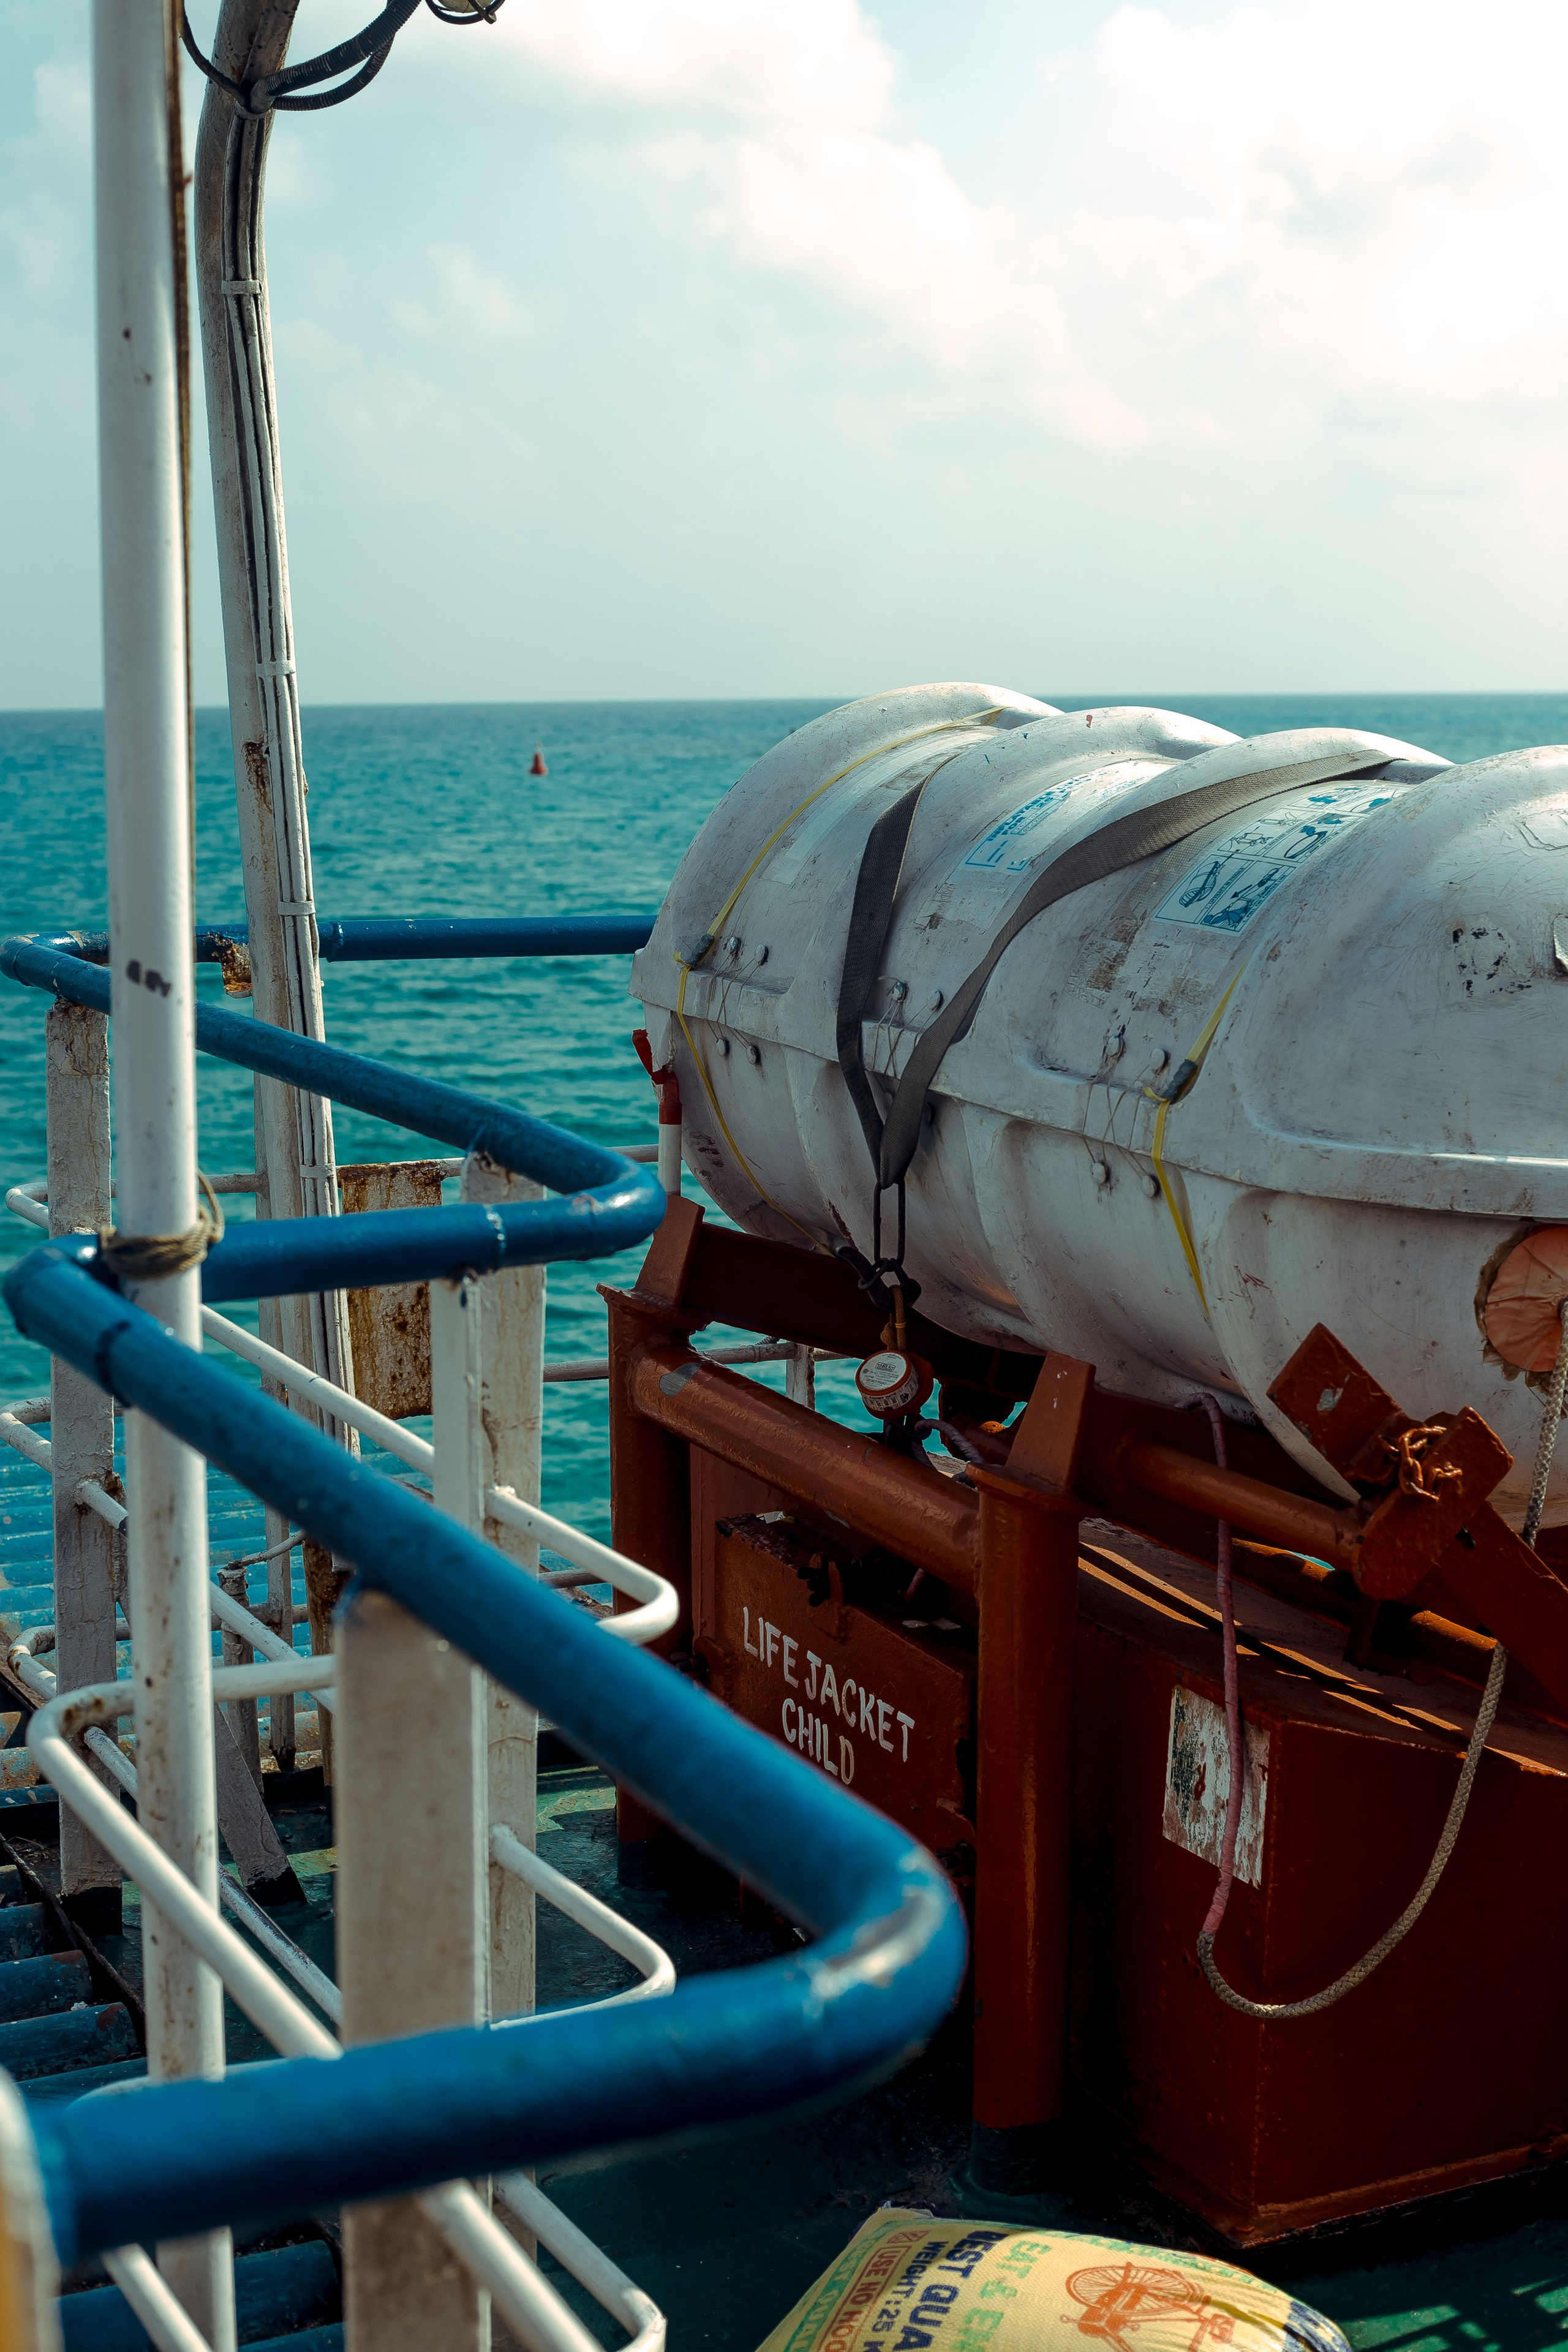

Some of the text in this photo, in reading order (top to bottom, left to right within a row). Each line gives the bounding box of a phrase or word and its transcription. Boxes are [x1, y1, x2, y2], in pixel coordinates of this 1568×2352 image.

[987, 791, 1055, 842] INFLATABLE
[1001, 816, 1027, 835] FOR
[742, 1606, 915, 1763] LIFE JACKET
[782, 1698, 854, 1785] CHILD
[892, 2230, 1009, 2352] BEST QUA
[980, 2280, 1018, 2299] &
[995, 2241, 1053, 2278] EAT
[787, 2289, 839, 2352] QUAL
[824, 2249, 899, 2352] USE NO HOO
